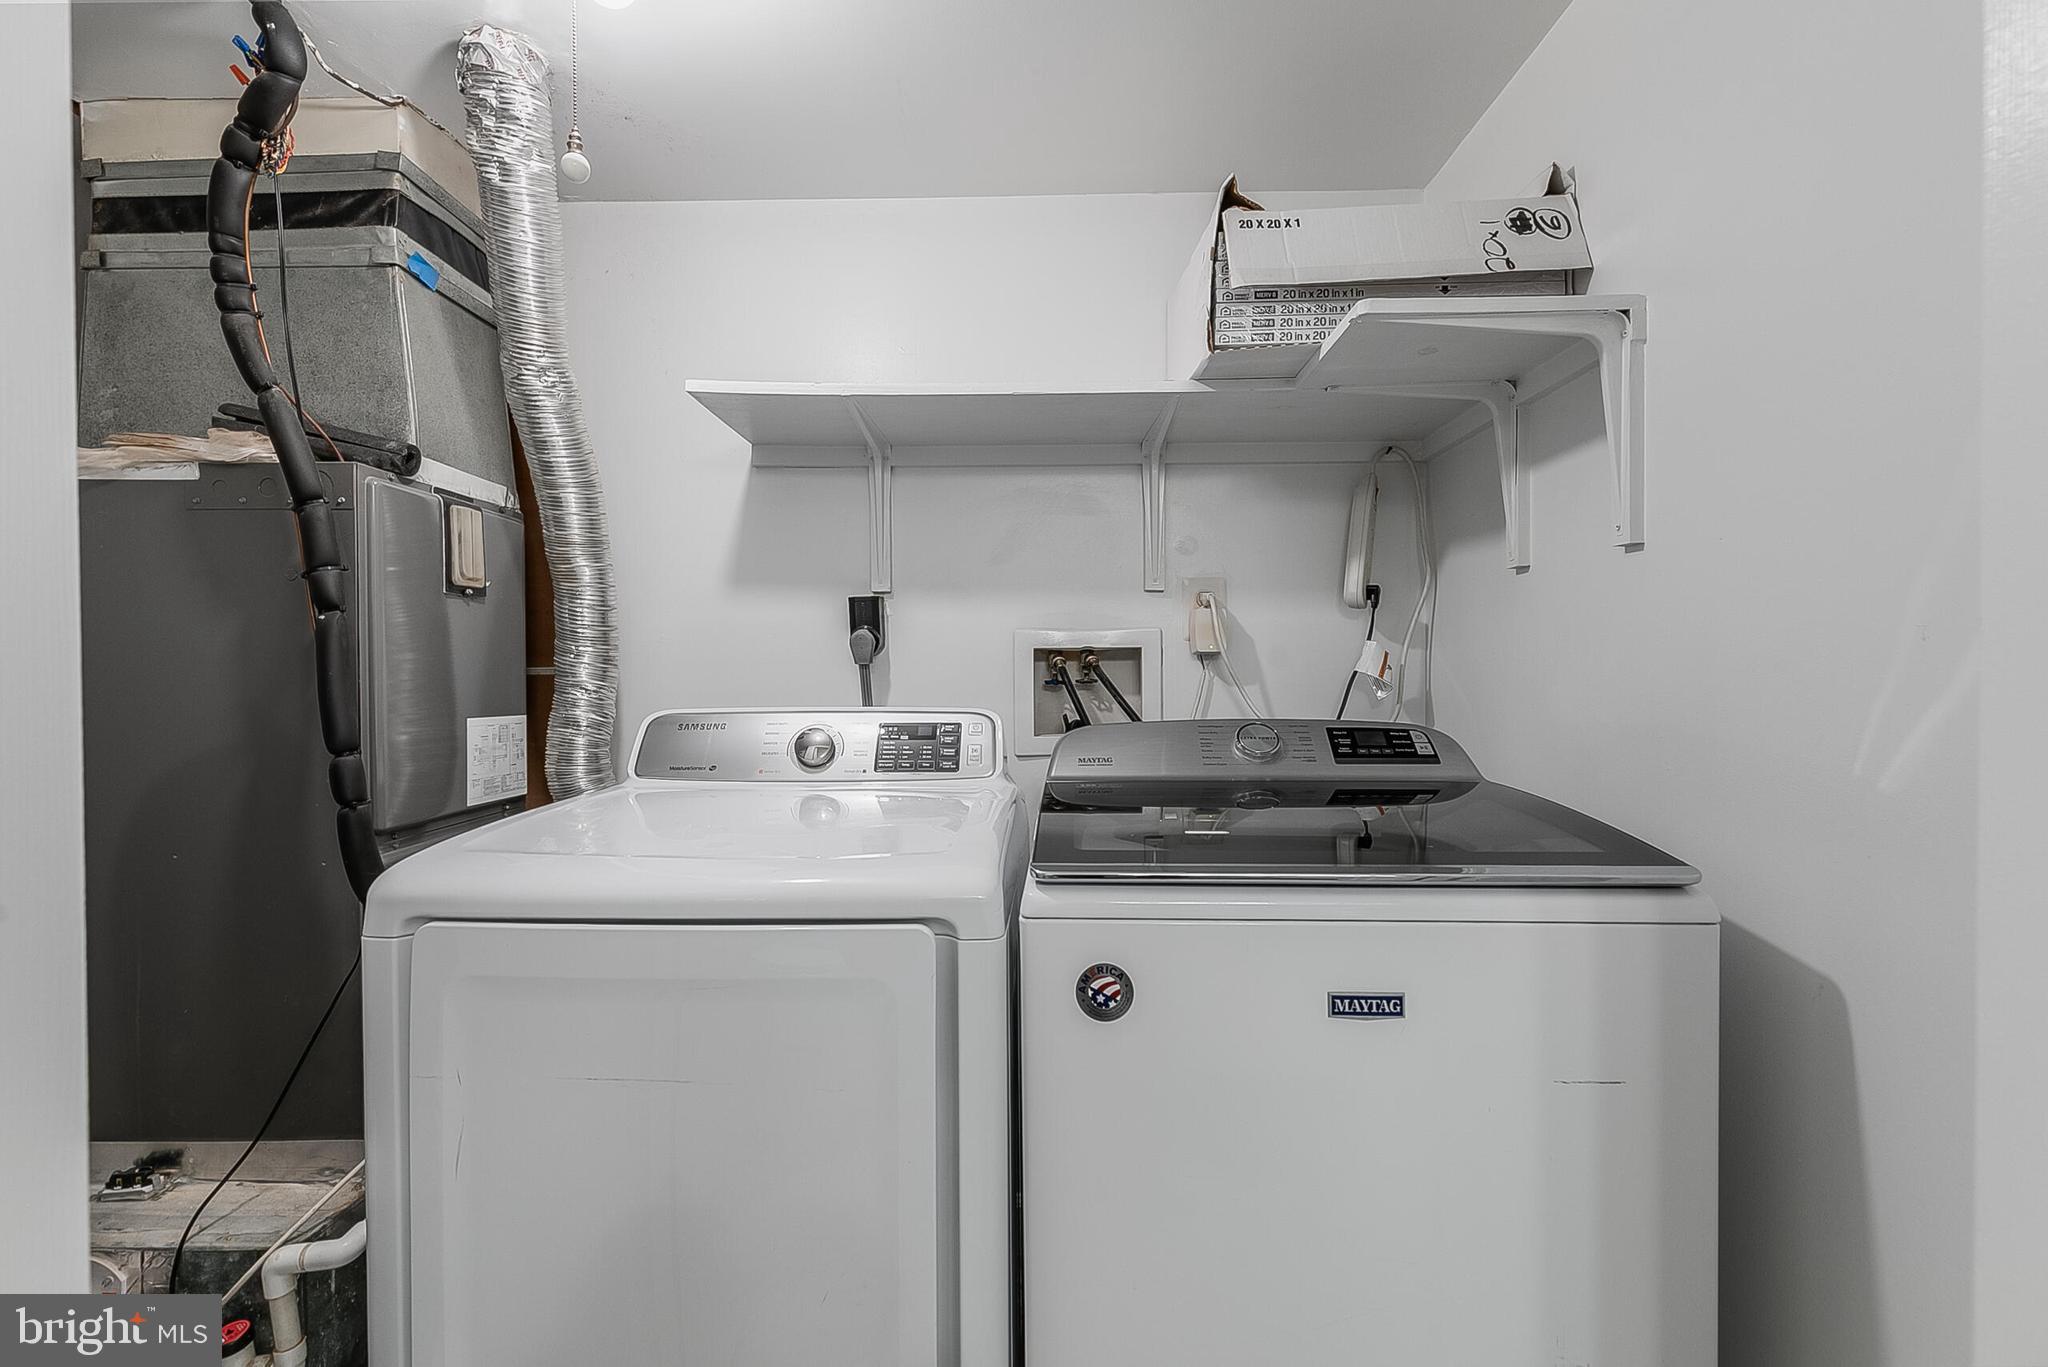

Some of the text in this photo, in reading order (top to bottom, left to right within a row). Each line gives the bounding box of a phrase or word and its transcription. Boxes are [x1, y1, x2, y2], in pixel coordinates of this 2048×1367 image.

[1238, 218, 1301, 229] 20 X 20 X 1
[1283, 289, 1296, 299] 20
[1298, 289, 1307, 299] in
[1316, 288, 1329, 298] 20
[1331, 288, 1341, 298] in
[1280, 304, 1294, 314] 20
[1306, 306, 1312, 314] x
[1328, 303, 1338, 313] in
[1279, 318, 1293, 327] 20
[1295, 318, 1304, 327] in
[1313, 317, 1326, 327] 20
[1328, 316, 1337, 326] in
[1279, 332, 1293, 341] 20
[1294, 332, 1303, 341] in
[1312, 331, 1326, 340] 20
[677, 723, 727, 731] SAMSUNG
[1078, 965, 1125, 994] AMERICA
[1333, 999, 1402, 1013] MAYTAG
